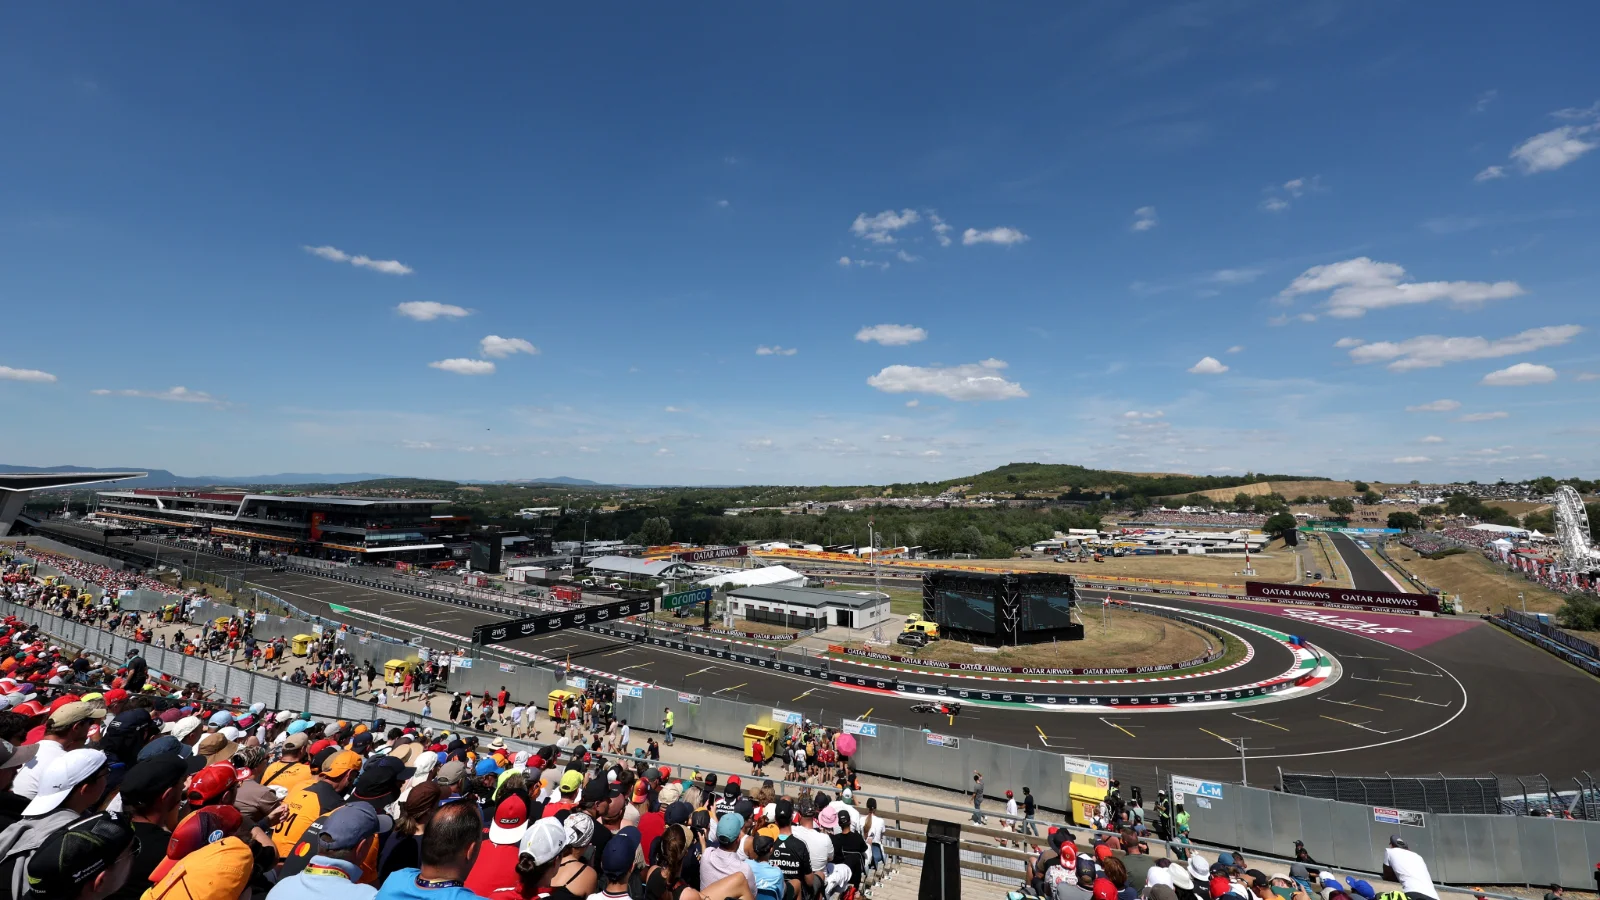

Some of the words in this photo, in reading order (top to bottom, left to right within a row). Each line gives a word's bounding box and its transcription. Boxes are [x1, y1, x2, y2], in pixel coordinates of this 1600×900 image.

[694, 550, 714, 560] QATAR
[715, 548, 738, 558] AIRWAYS
[671, 590, 706, 605] aramco
[1262, 588, 1290, 596] QATAR
[1293, 590, 1330, 599] AIRWAYS
[1341, 594, 1373, 602] QATAR
[1376, 597, 1418, 606] AIRWAYS
[574, 613, 585, 621] aws
[598, 609, 608, 617] aws
[521, 622, 535, 631] aws
[548, 618, 561, 626] aws
[492, 628, 506, 637] aws
[867, 652, 891, 660] AIRWAYS
[923, 660, 949, 668] AIRWAYS
[1090, 767, 1107, 776] L-M
[1201, 786, 1221, 796] L-M
[212, 830, 222, 842] hp
